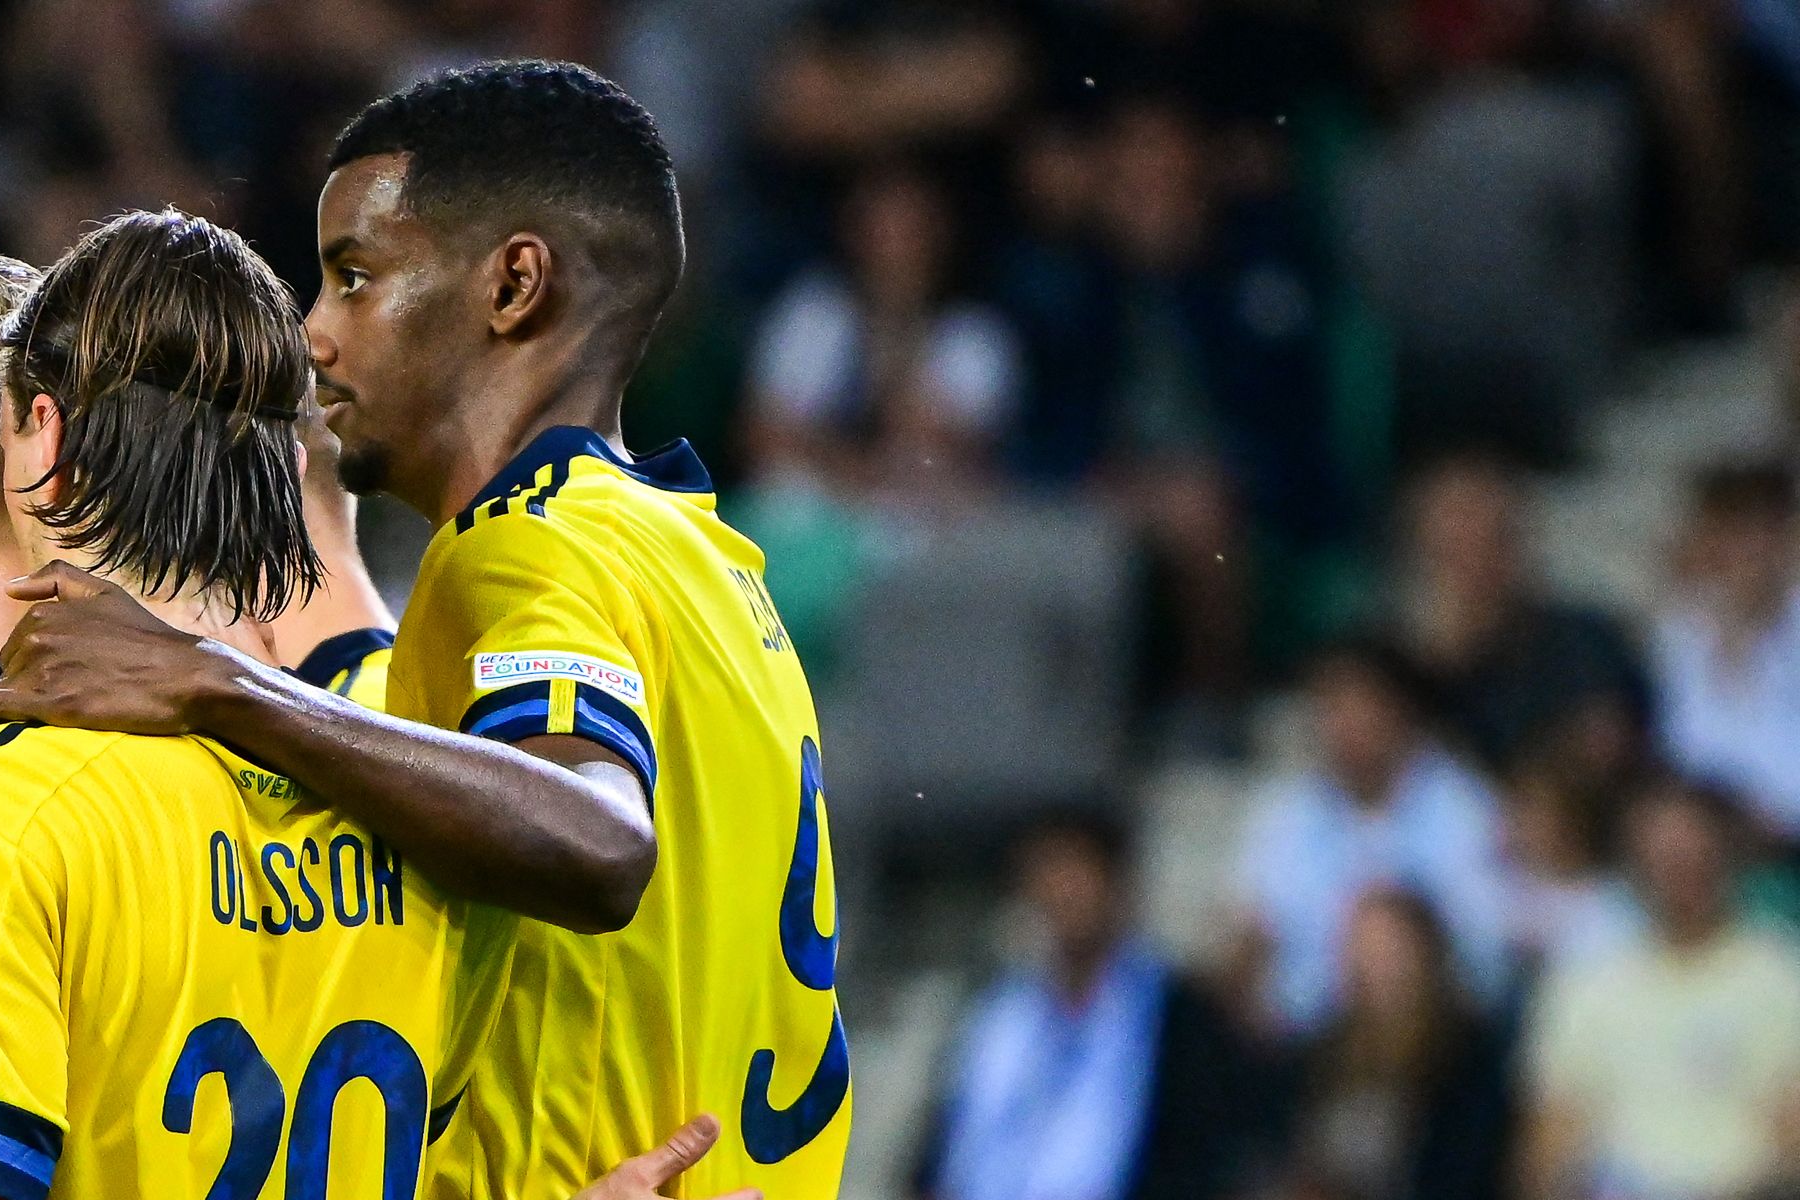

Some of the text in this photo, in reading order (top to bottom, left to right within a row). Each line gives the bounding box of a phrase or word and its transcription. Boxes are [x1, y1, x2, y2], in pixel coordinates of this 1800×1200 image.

[480, 654, 516, 664] UEFA
[480, 660, 638, 692] FOUNDATION
[210, 830, 404, 936] OLSSON
[741, 735, 850, 1165] 9
